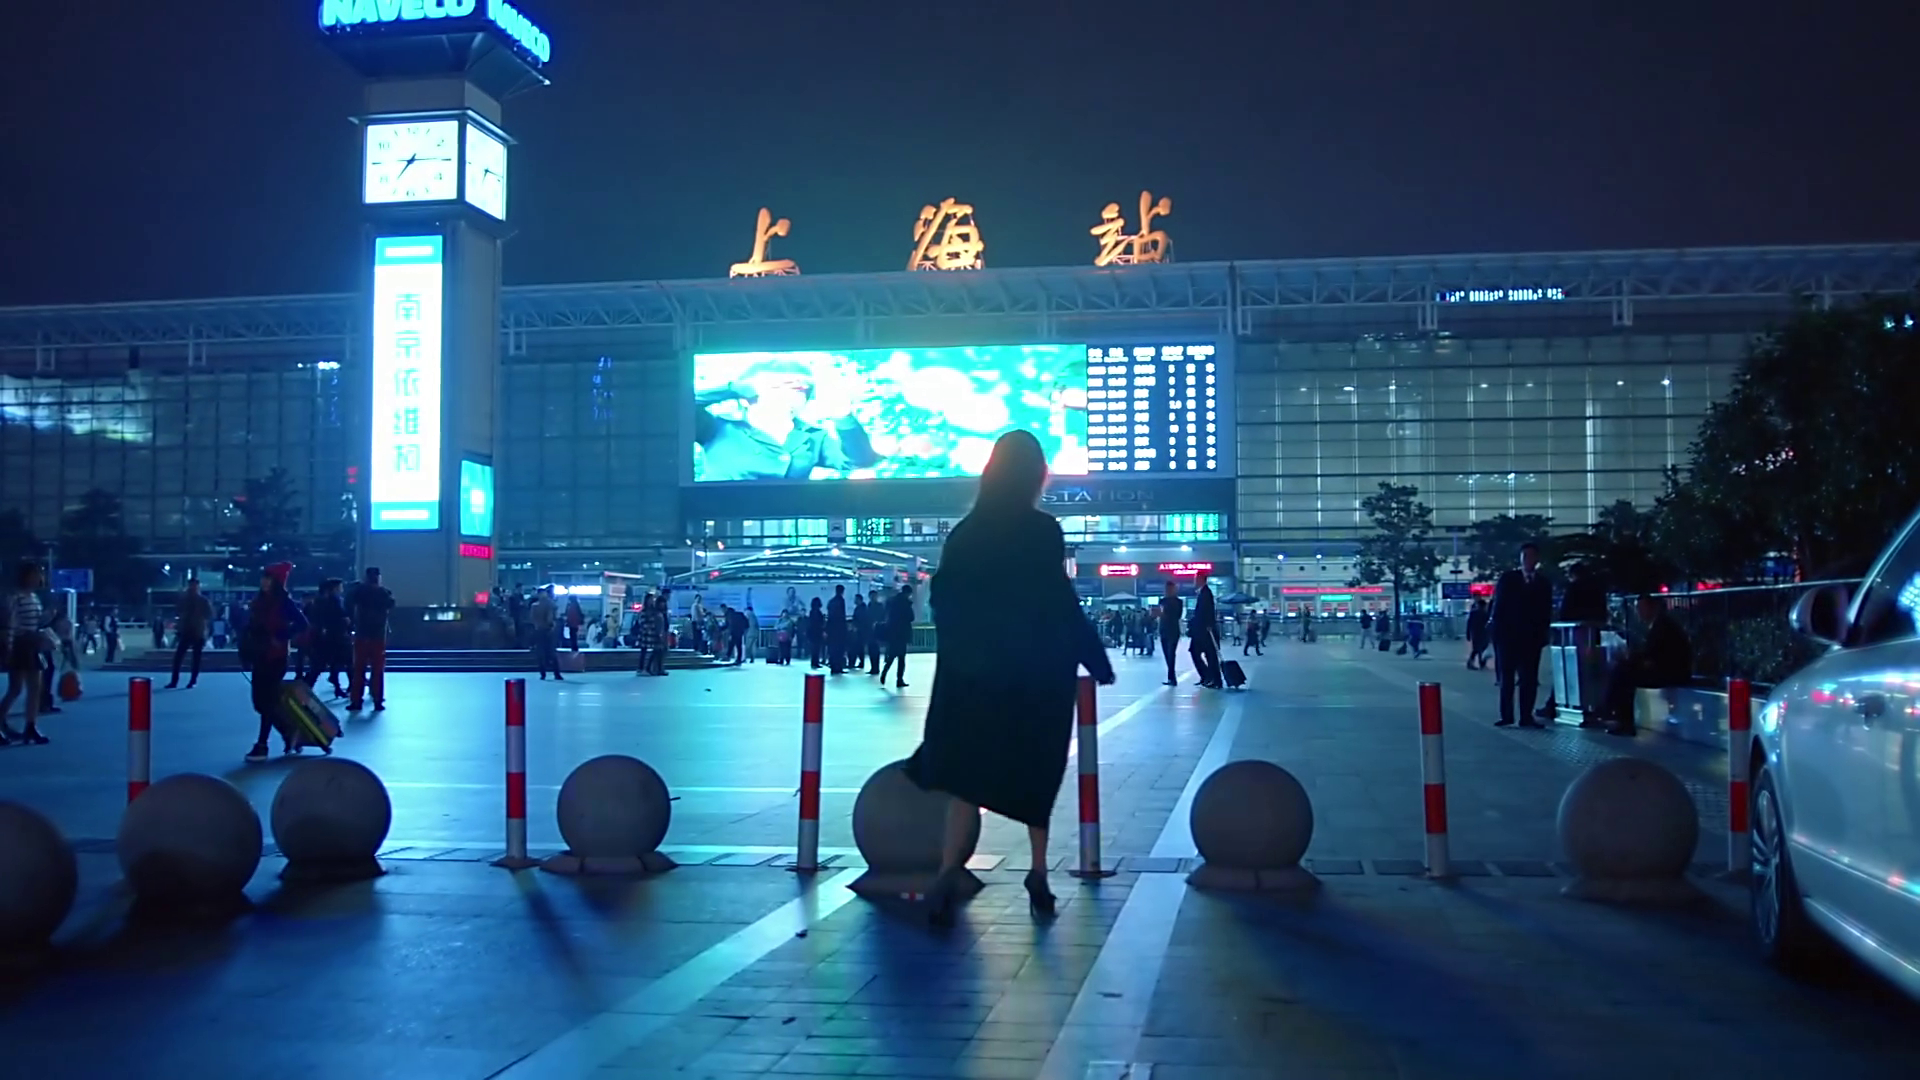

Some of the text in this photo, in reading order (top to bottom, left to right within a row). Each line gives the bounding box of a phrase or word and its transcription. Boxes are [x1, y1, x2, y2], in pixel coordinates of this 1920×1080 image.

[322, 0, 476, 25] NAVECO
[729, 190, 1171, 274] 上海站
[394, 293, 423, 473] 南京依维柯
[1041, 490, 1154, 502] STATION
